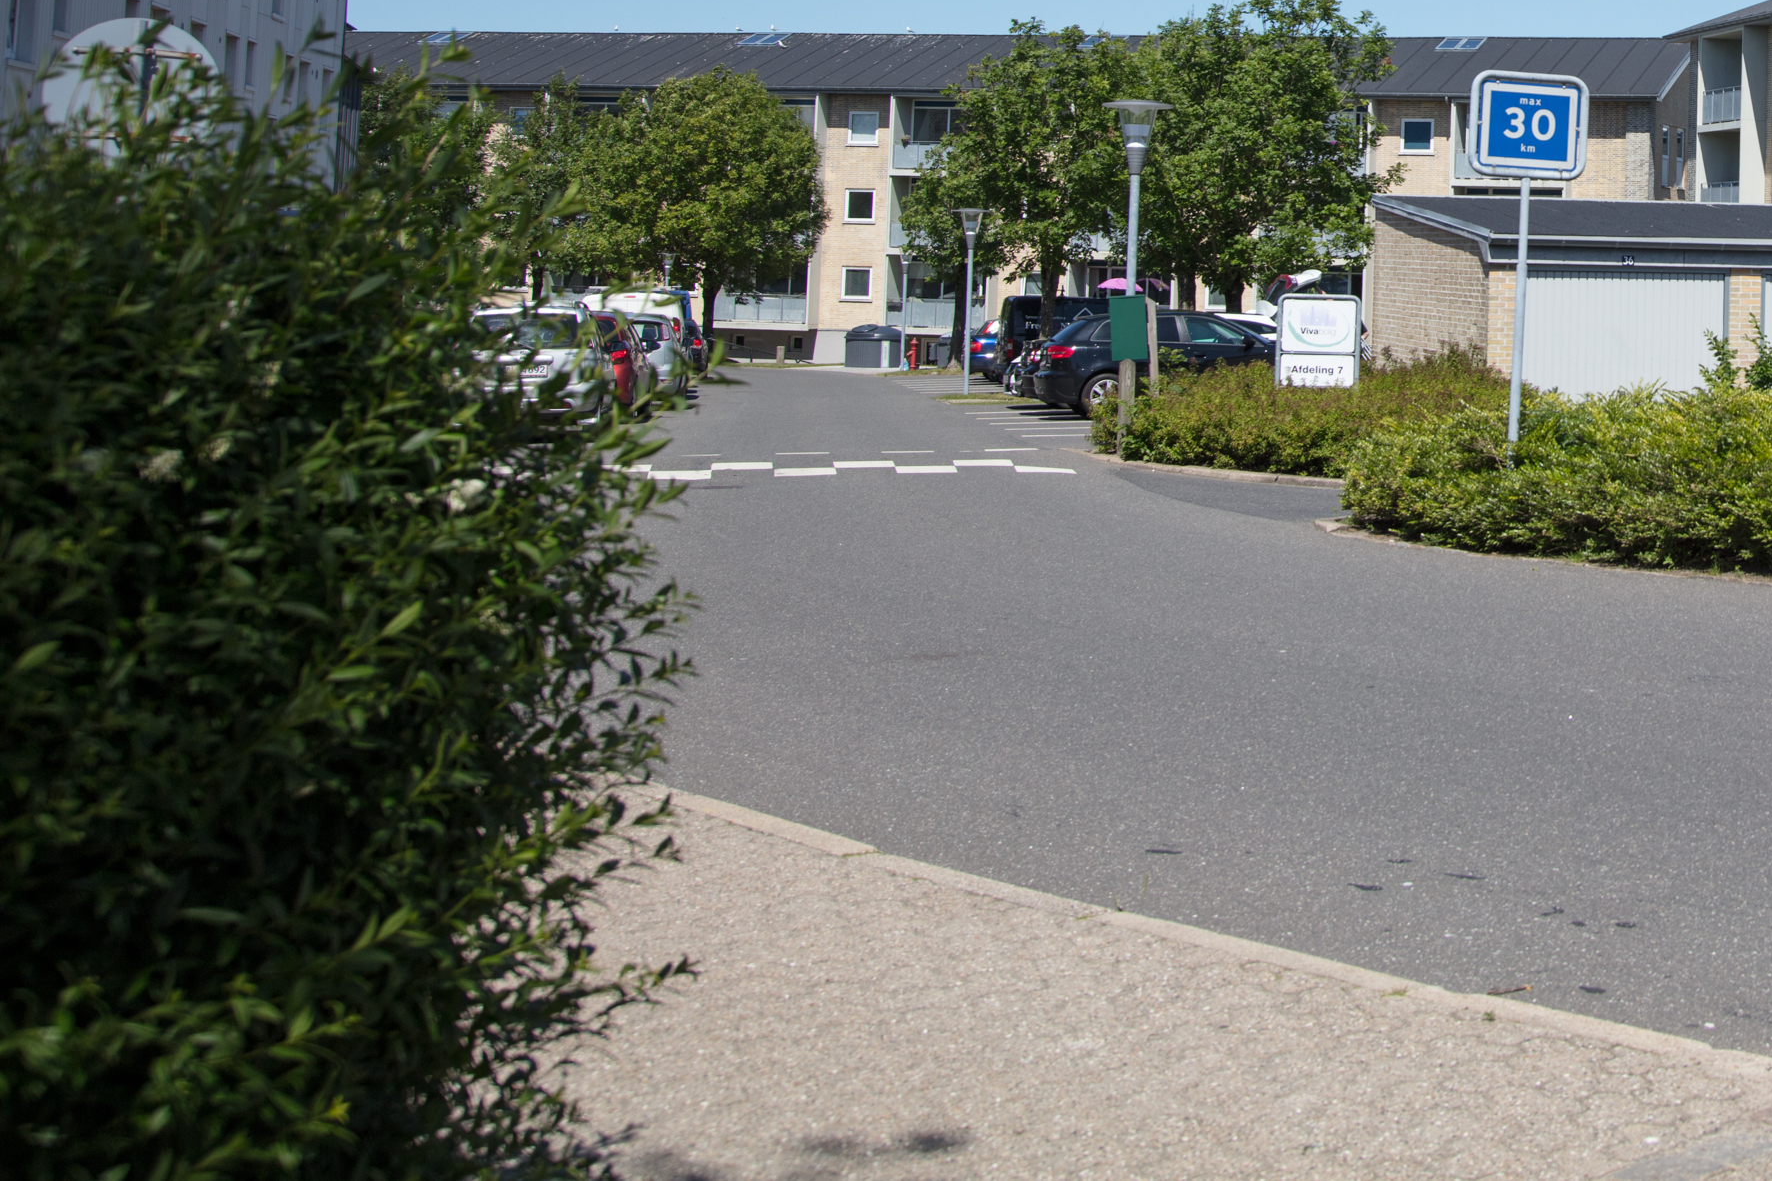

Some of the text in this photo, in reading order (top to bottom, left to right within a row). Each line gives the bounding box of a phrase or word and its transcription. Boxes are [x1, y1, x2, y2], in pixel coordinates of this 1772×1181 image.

[1519, 97, 1542, 106] max
[1502, 106, 1556, 141] 30
[1520, 143, 1536, 153] km
[1622, 256, 1634, 266] 36
[1300, 327, 1337, 337] Vivabolig
[1291, 365, 1344, 376] Afdeling 7
